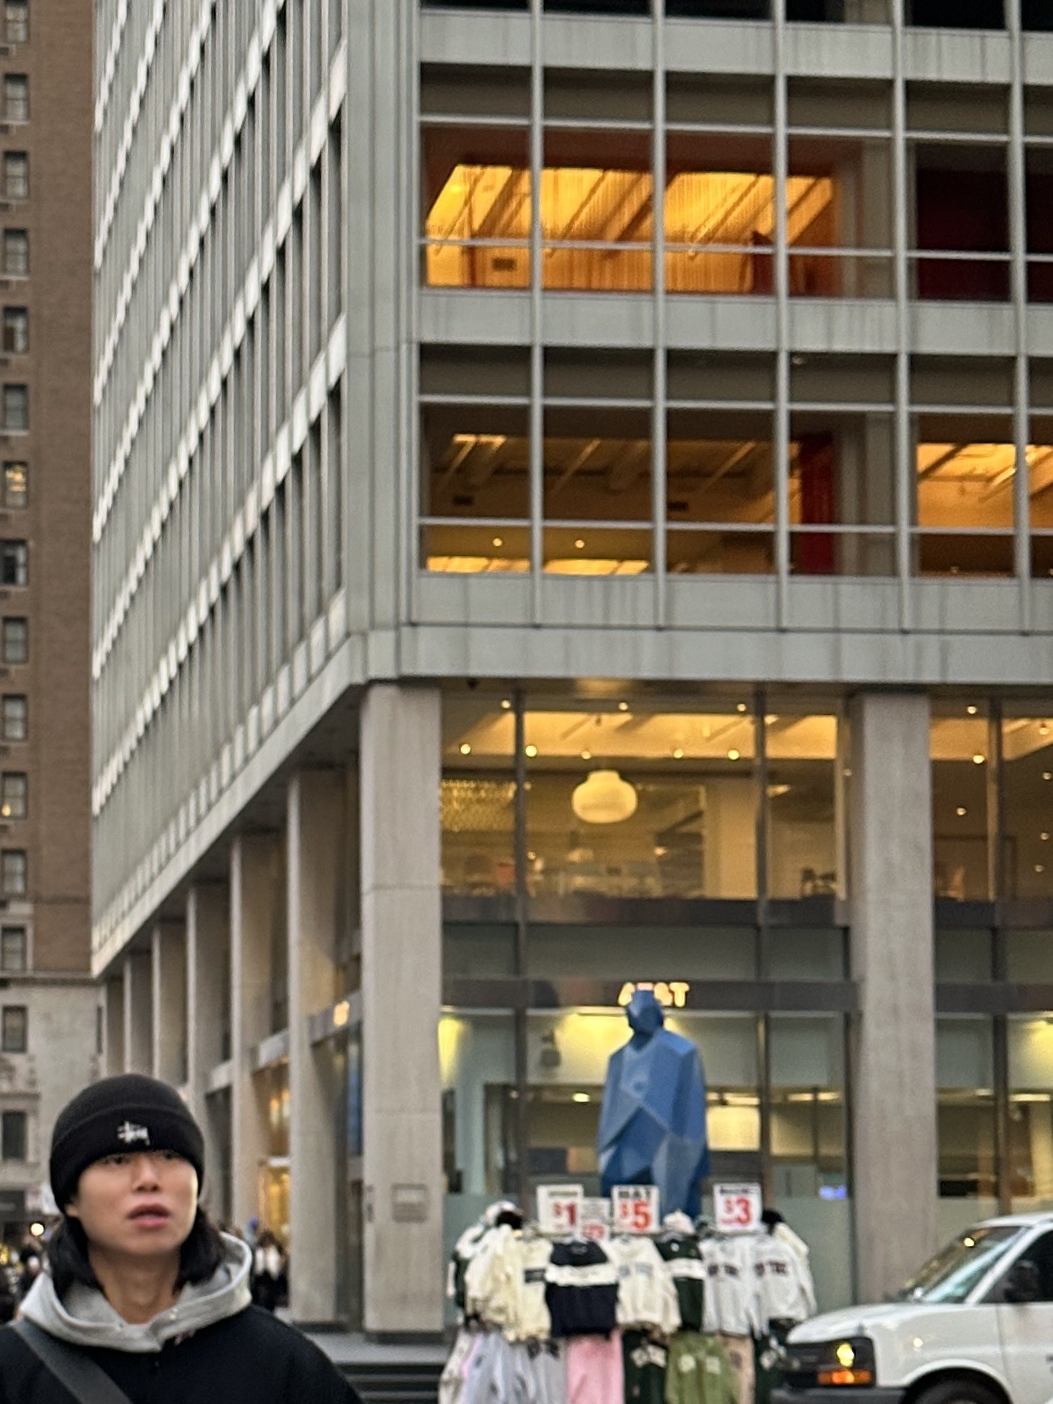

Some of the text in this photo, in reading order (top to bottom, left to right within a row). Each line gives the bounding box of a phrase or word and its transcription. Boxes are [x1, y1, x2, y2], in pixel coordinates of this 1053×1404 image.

[553, 1202, 577, 1227] $1
[620, 1201, 652, 1231] $5
[723, 1197, 754, 1226] $3
